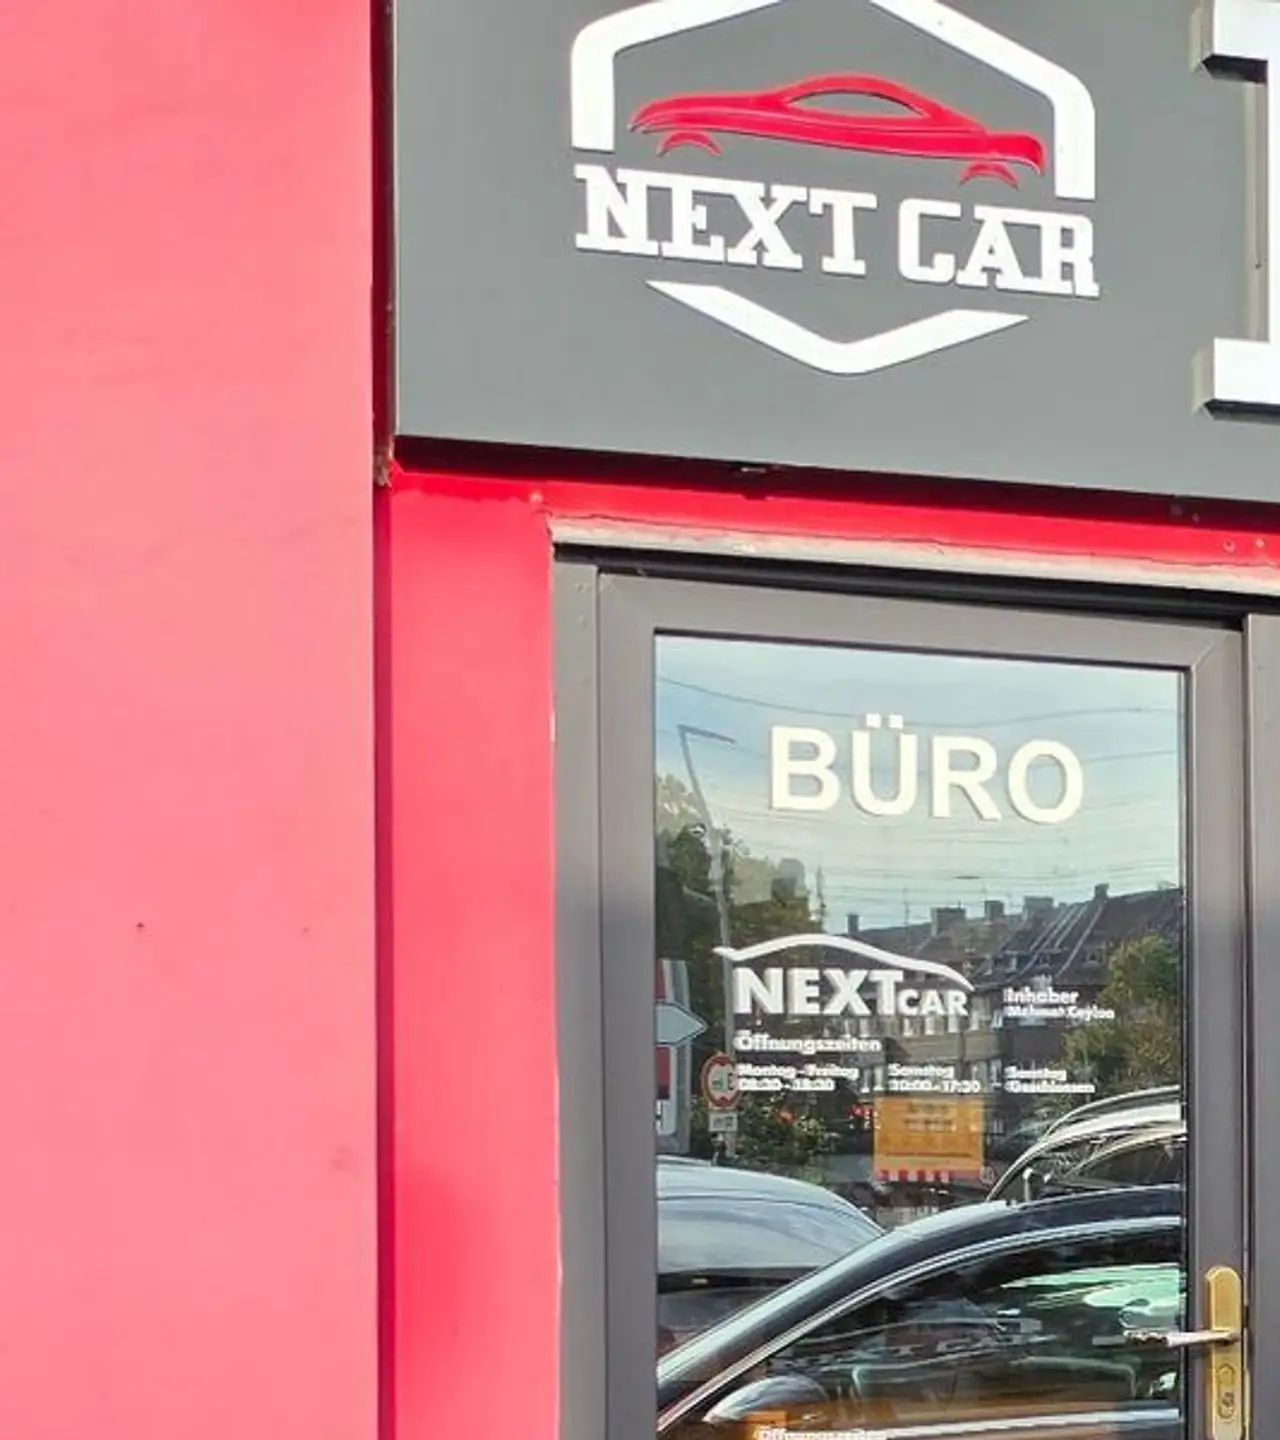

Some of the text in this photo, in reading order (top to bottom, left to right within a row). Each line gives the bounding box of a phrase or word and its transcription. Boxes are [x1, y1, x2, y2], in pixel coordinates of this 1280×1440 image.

[573, 163, 1100, 298] NEXT CAR
[768, 712, 1085, 825] BÜRO
[732, 1029, 882, 1056] Öffnungszeiten
